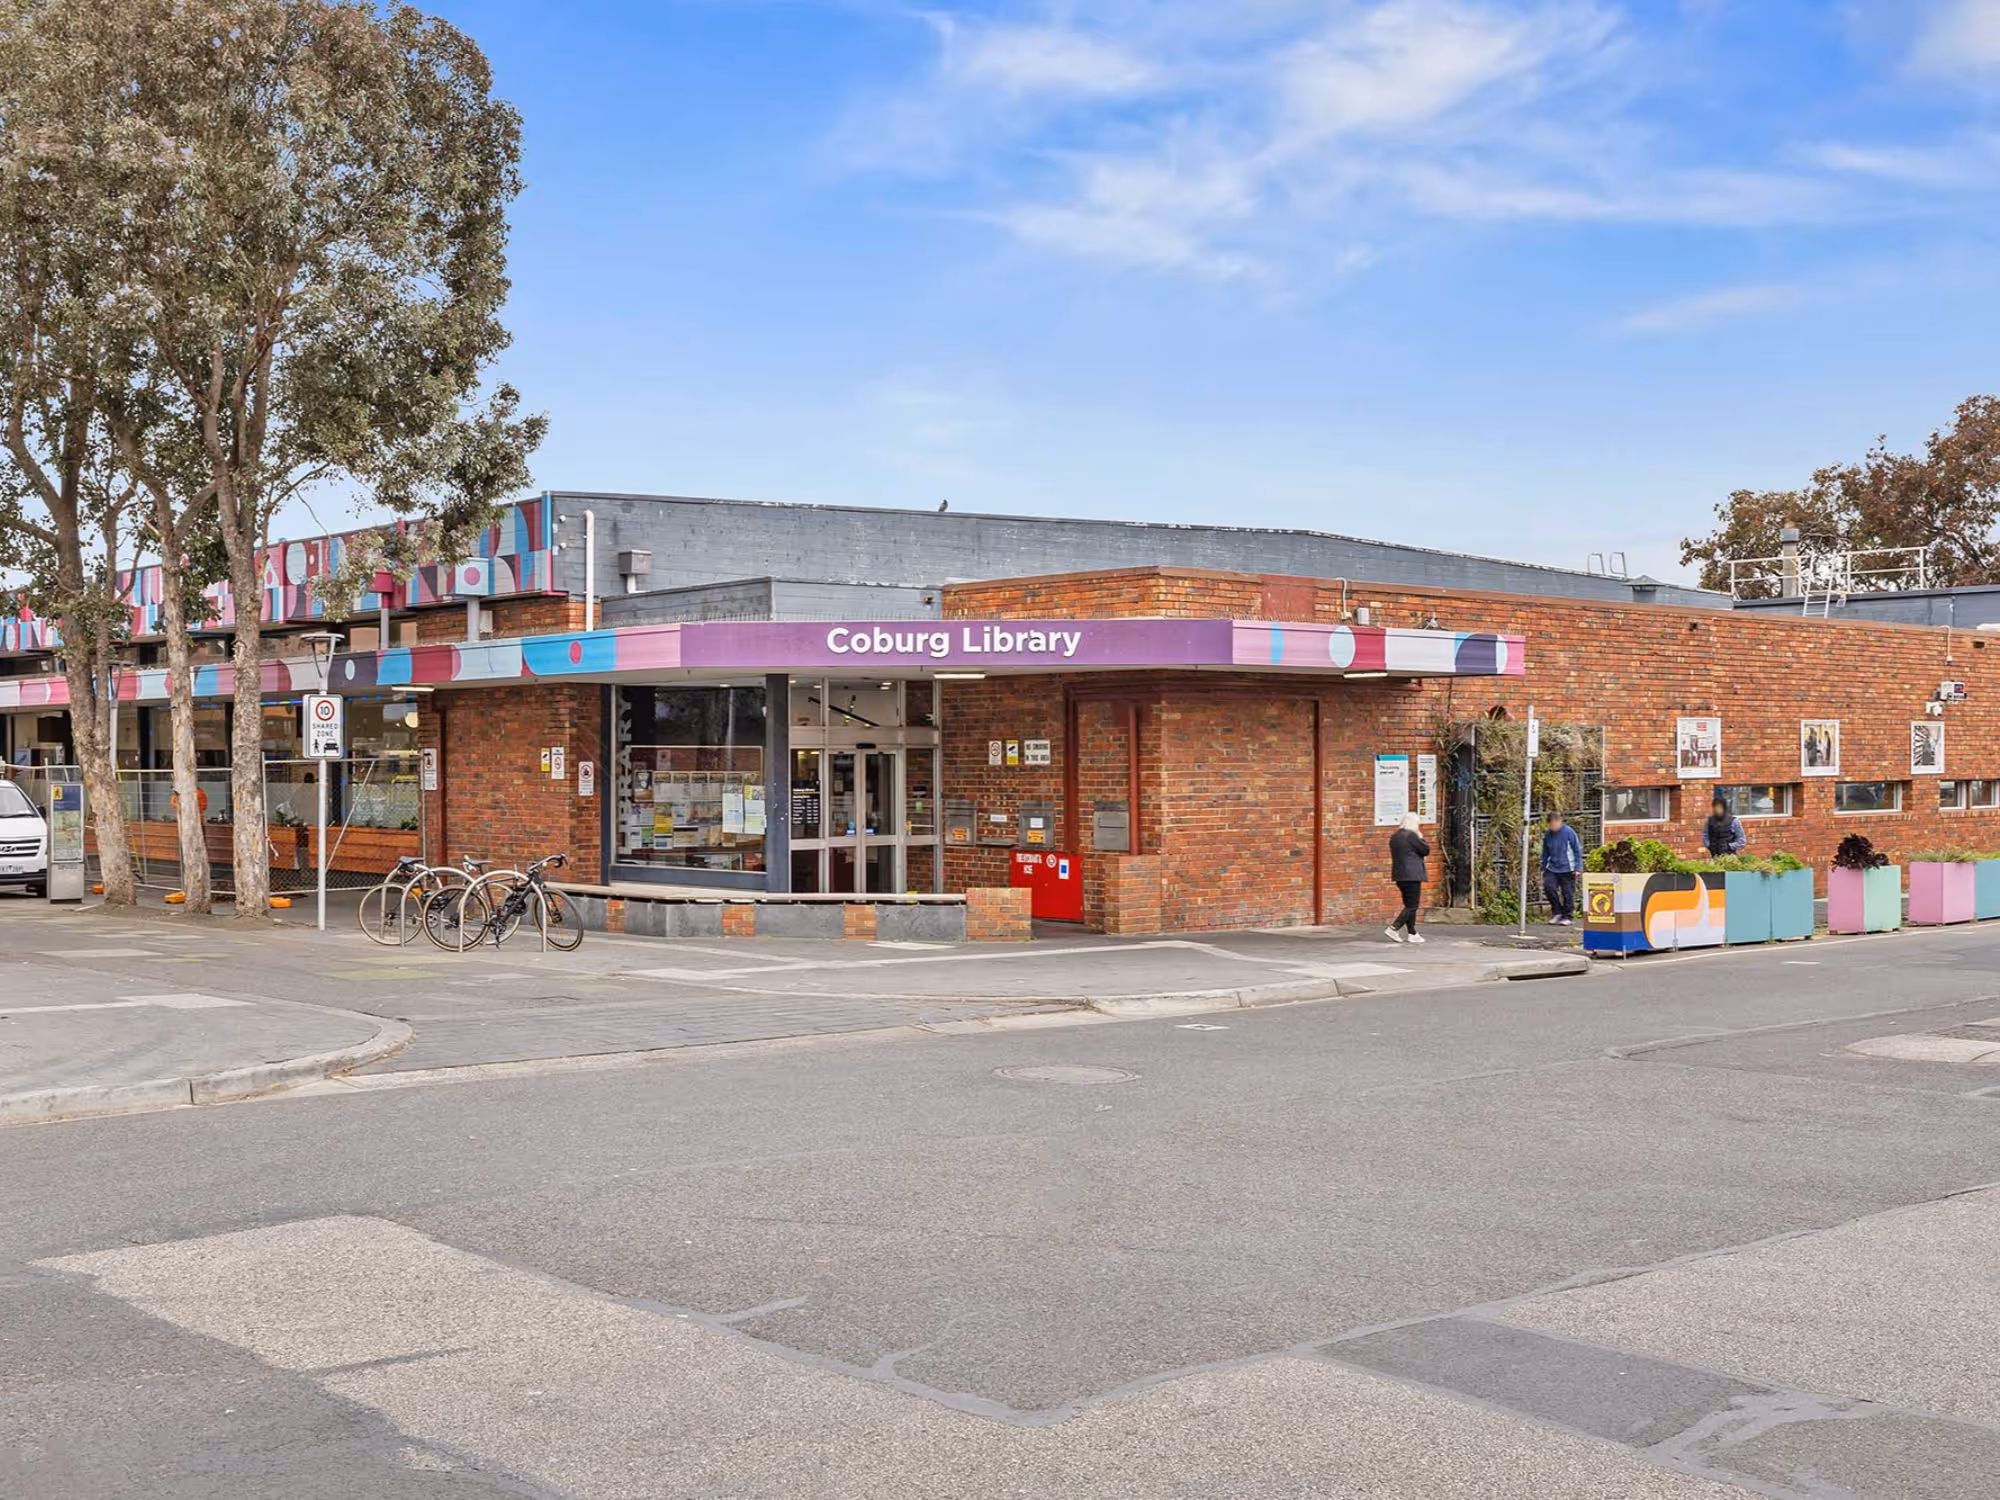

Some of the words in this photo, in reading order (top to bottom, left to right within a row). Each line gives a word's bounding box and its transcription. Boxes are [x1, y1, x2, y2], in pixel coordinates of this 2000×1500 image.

[826, 627, 950, 658] Coburg
[962, 626, 1082, 657] Library
[320, 706, 330, 716] 10
[616, 695, 632, 854] LIBRARY
